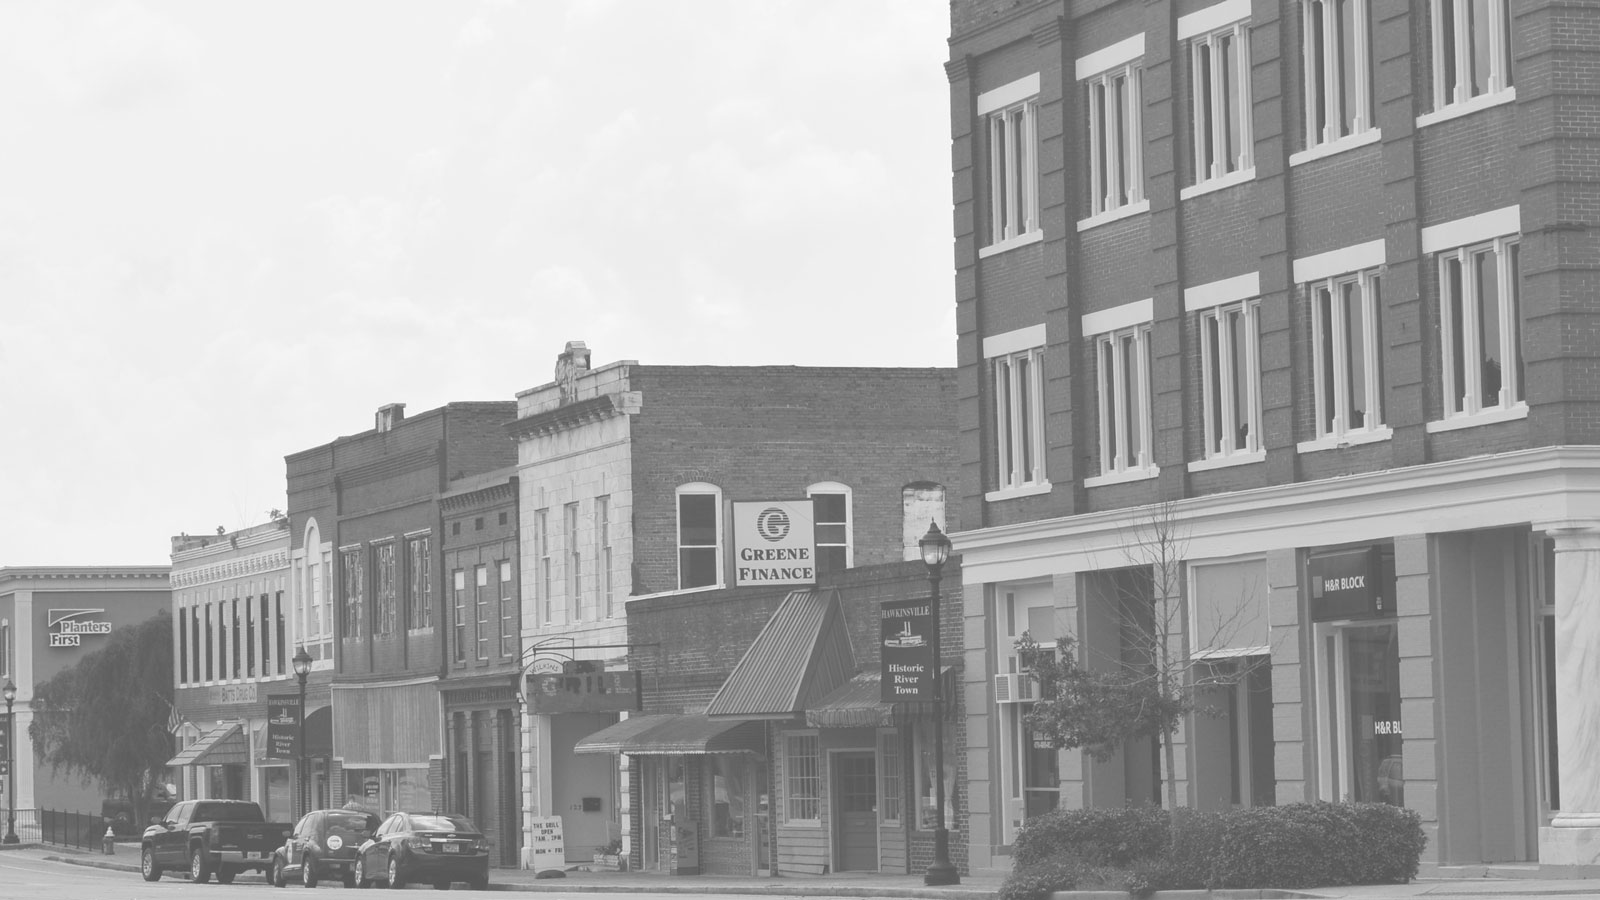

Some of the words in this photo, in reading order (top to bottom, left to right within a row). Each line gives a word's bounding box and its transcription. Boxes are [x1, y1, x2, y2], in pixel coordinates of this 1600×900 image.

[741, 548, 809, 561] GREENE
[739, 567, 813, 581] FINANCE
[1325, 579, 1340, 592] H&R
[1341, 576, 1365, 590] BLOCK
[881, 606, 930, 619] HAWKINSVILLE
[62, 622, 110, 633] Planters
[52, 635, 79, 645] First
[888, 664, 924, 673] Historic
[894, 675, 919, 684] River
[894, 686, 919, 695] Town
[1374, 720, 1392, 735] H&R
